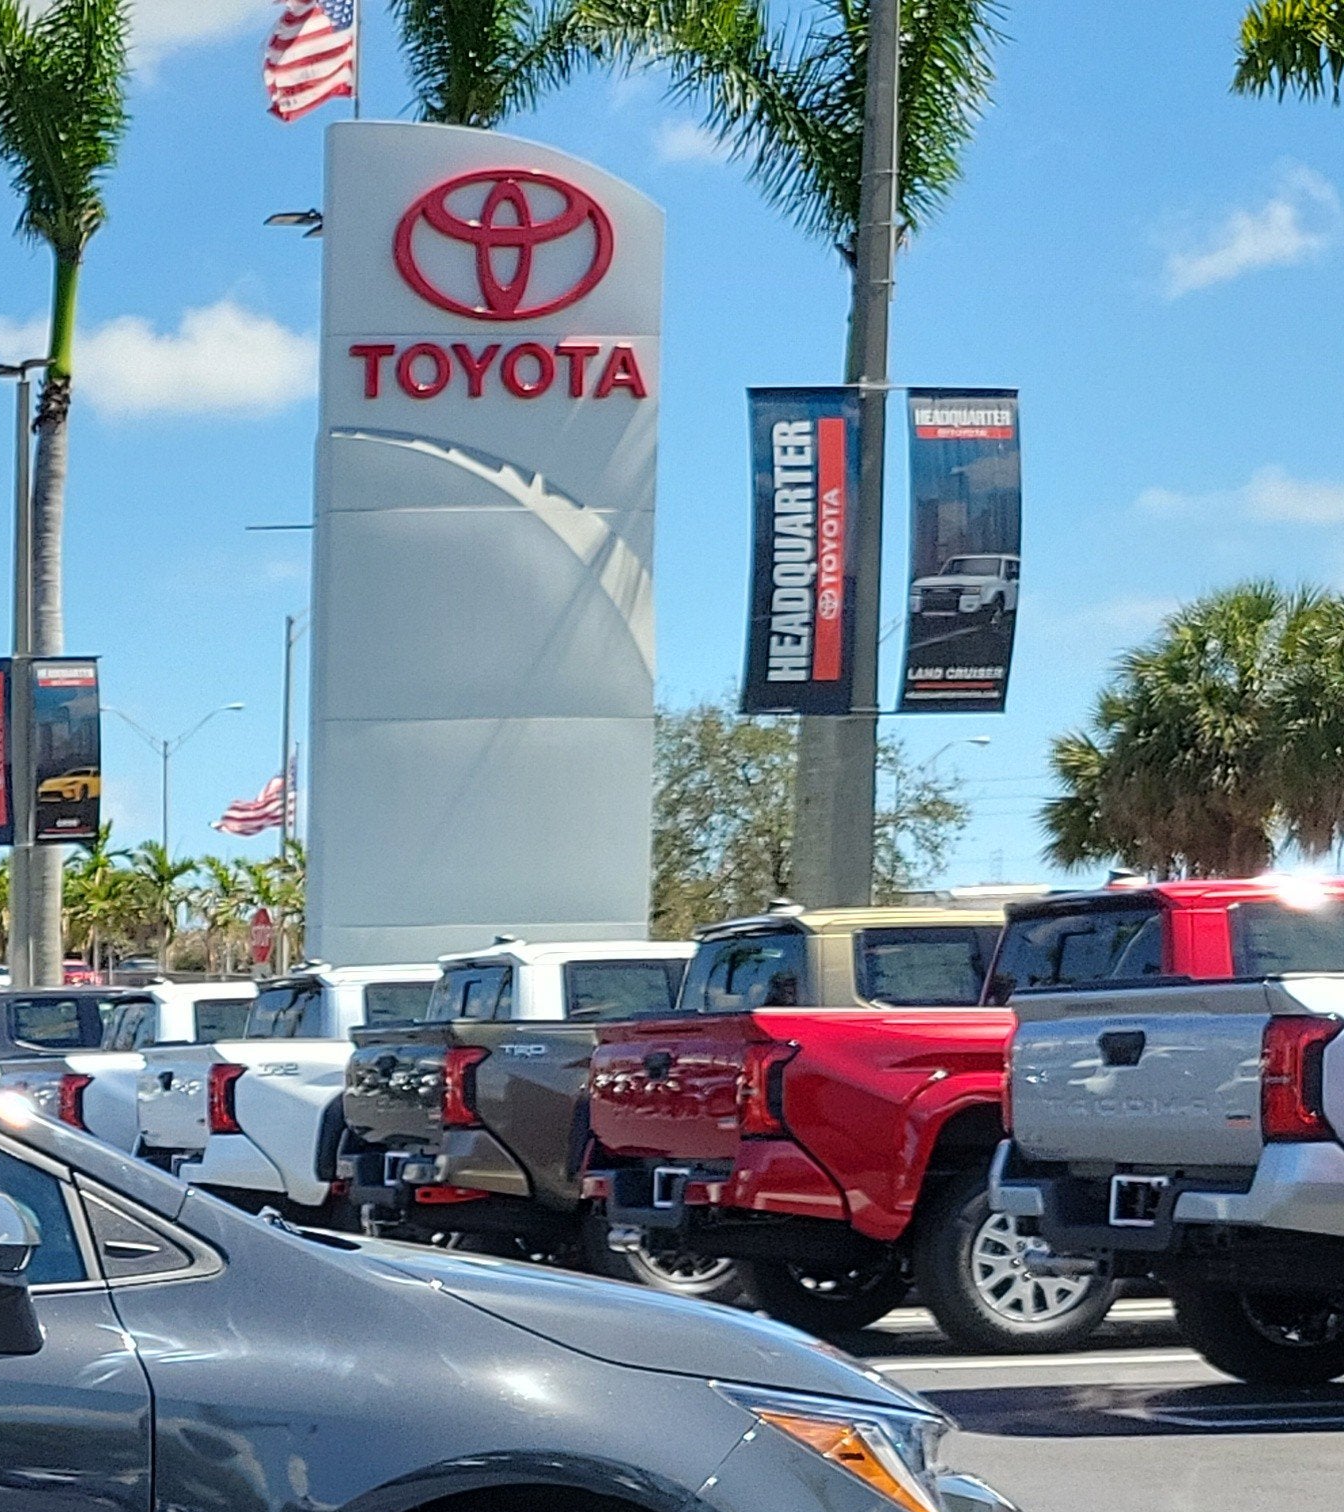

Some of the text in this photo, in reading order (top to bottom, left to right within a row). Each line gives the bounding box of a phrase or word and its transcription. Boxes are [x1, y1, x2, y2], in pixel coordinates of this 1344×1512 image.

[348, 342, 648, 400] TOYOTA
[915, 410, 1011, 427] HEADQUARTER
[766, 419, 818, 682] HEADQUARTER
[822, 487, 842, 586] TOYOTA
[907, 666, 1004, 680] LAND CRUISER
[498, 1044, 545, 1057] TRD
